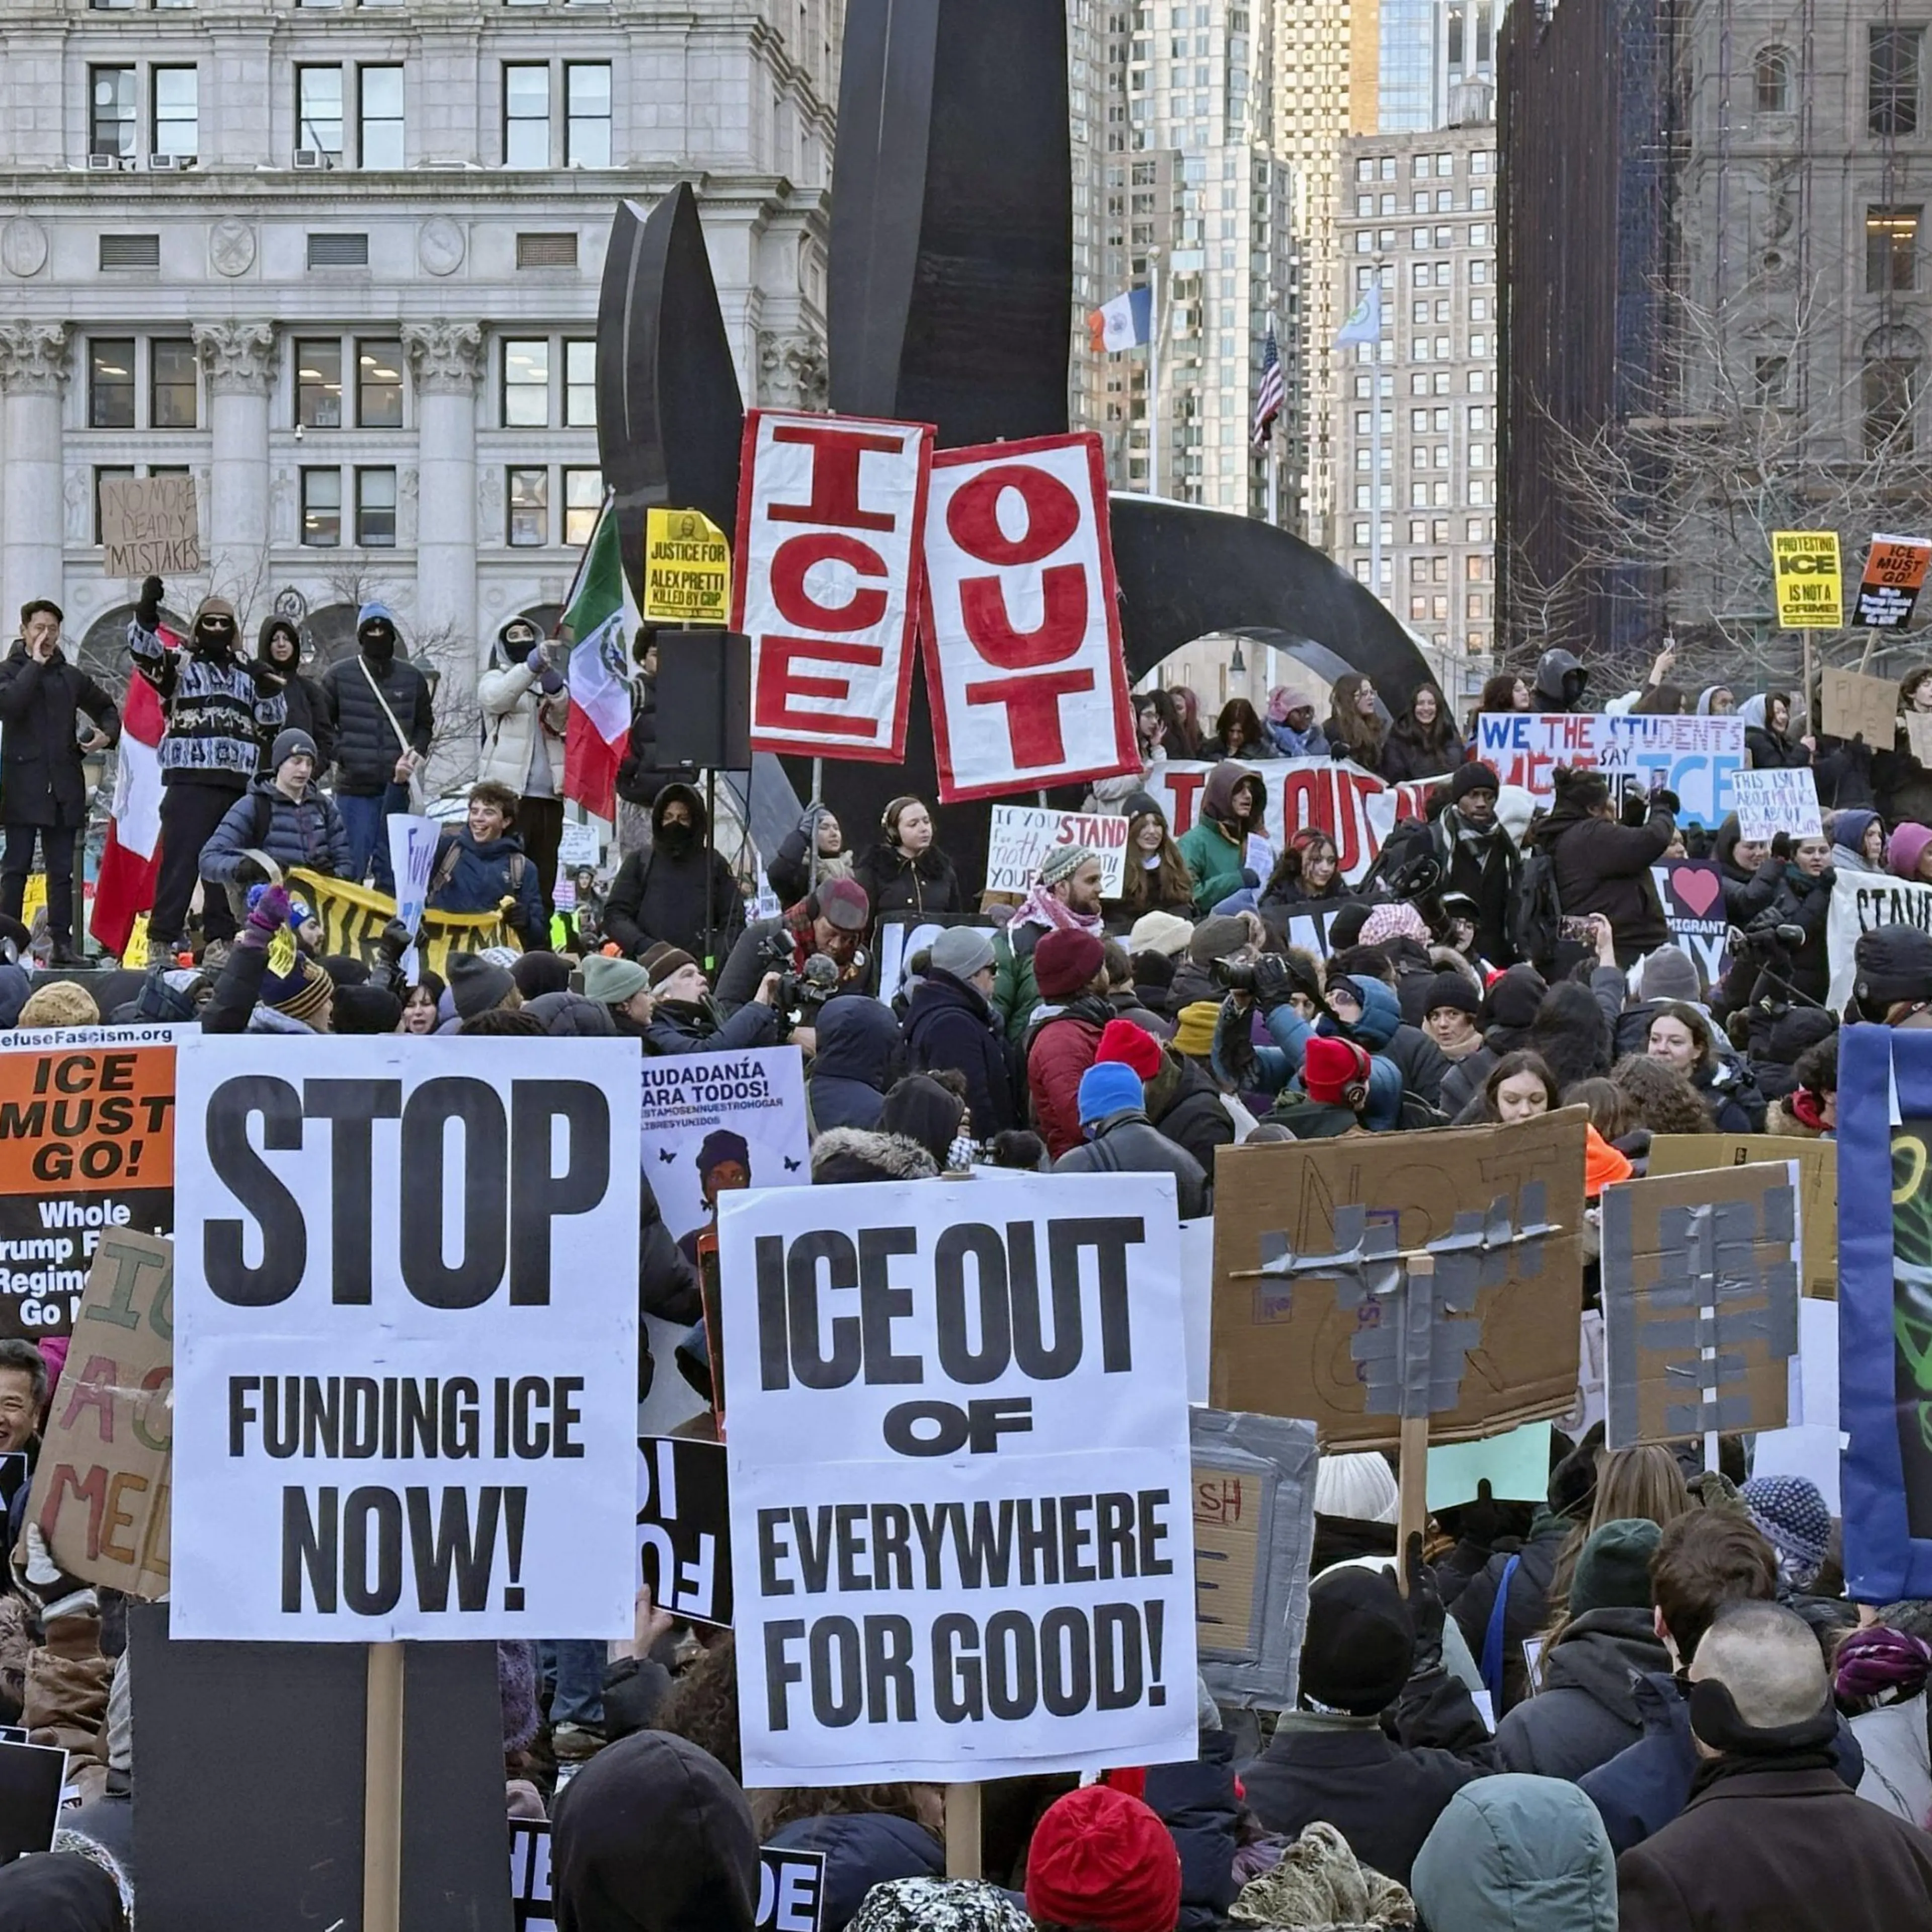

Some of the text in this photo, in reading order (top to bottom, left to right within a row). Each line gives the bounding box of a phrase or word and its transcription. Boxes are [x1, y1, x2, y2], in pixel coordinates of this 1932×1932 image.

[109, 478, 197, 516] NO MORE
[122, 512, 186, 542] DEADLY
[111, 538, 200, 576] MISTAKES
[651, 541, 726, 562] JUSTICE FOR
[1779, 554, 1837, 575] ICE
[1877, 557, 1923, 572] MUST
[1889, 544, 1915, 559] ICE
[651, 569, 724, 591] ALEX PRETTI
[756, 426, 904, 738] ICE
[1789, 584, 1831, 601] IS NOT A
[653, 589, 684, 604] KILLED
[686, 591, 699, 605] BY
[946, 464, 1095, 770] OUT
[1481, 717, 1743, 751] WE THE STUDENTS
[1599, 748, 1631, 766] SAY
[1734, 773, 1764, 789] THIS
[1022, 812, 1061, 830] YOU
[1057, 815, 1127, 848] STAND
[1665, 918, 1726, 935] MIGRANT
[0, 1029, 173, 1046] efuseFascism.org
[33, 1054, 138, 1094] ICE
[641, 1057, 766, 1087] IUDADANÍA
[642, 1080, 769, 1107] ARA TODOS!
[0, 1095, 175, 1140] MUST
[32, 1140, 144, 1181] GO!
[202, 1075, 610, 1310] STOP
[38, 1199, 131, 1228] Whole
[0, 1235, 73, 1264] rump
[20, 1299, 61, 1326] Go
[755, 1226, 925, 1392] ICE
[934, 1216, 1147, 1385] OUT
[228, 1376, 480, 1460] FUNDING
[494, 1376, 585, 1460] ICE
[882, 1397, 1033, 1458] OF
[281, 1485, 528, 1616] NOW!
[758, 1488, 1174, 1597] EVERYWHERE
[763, 1598, 1167, 1732] FOR GOOD!
